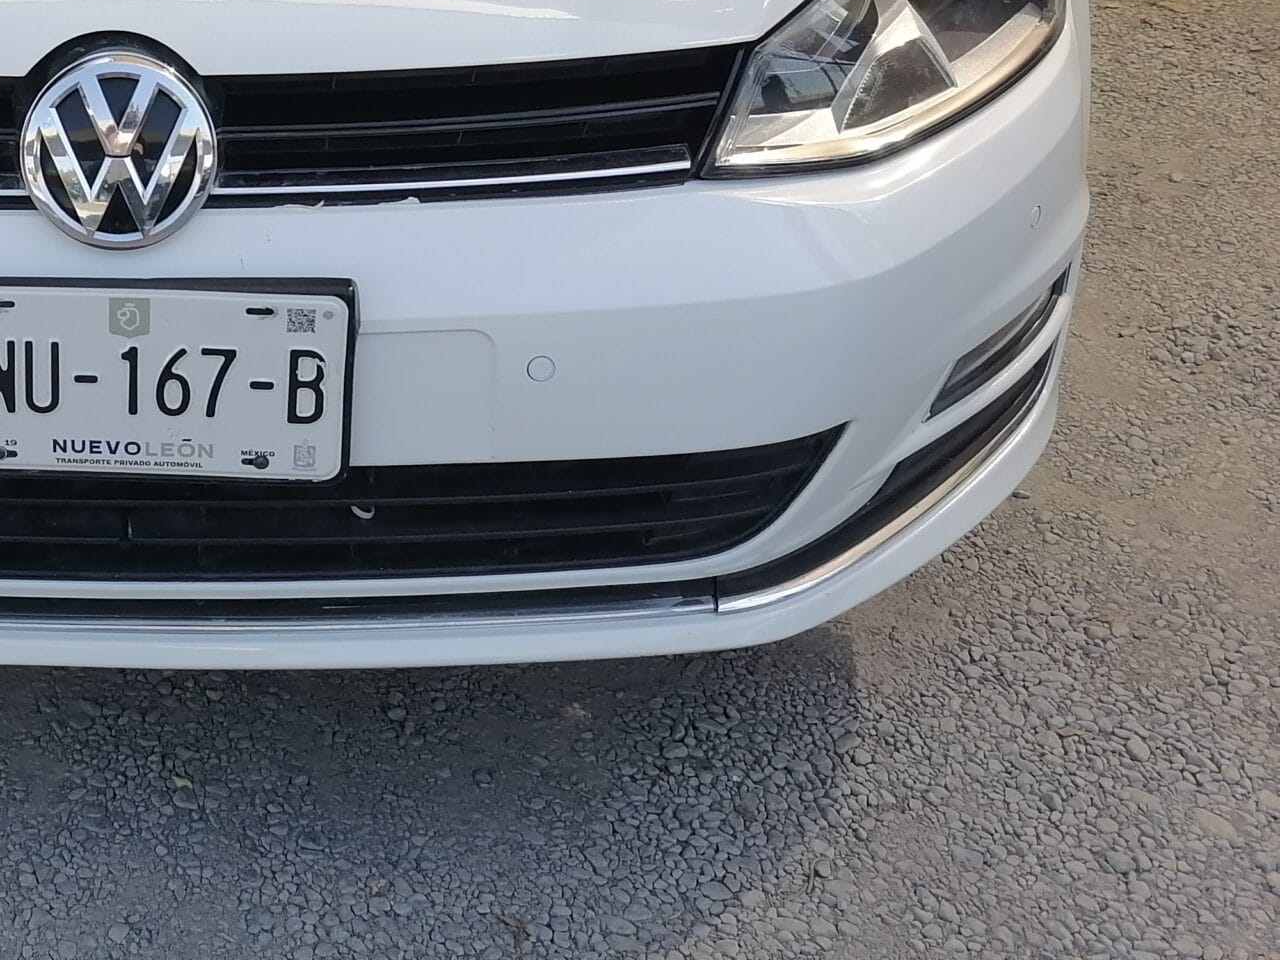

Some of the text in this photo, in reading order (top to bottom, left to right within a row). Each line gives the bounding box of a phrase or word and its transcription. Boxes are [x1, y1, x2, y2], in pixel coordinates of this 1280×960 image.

[22, 51, 217, 251] VW
[240, 448, 276, 457] MÉXICO
[55, 457, 204, 469] TRANSPORTE PRIVADO AUTOMÓVIL
